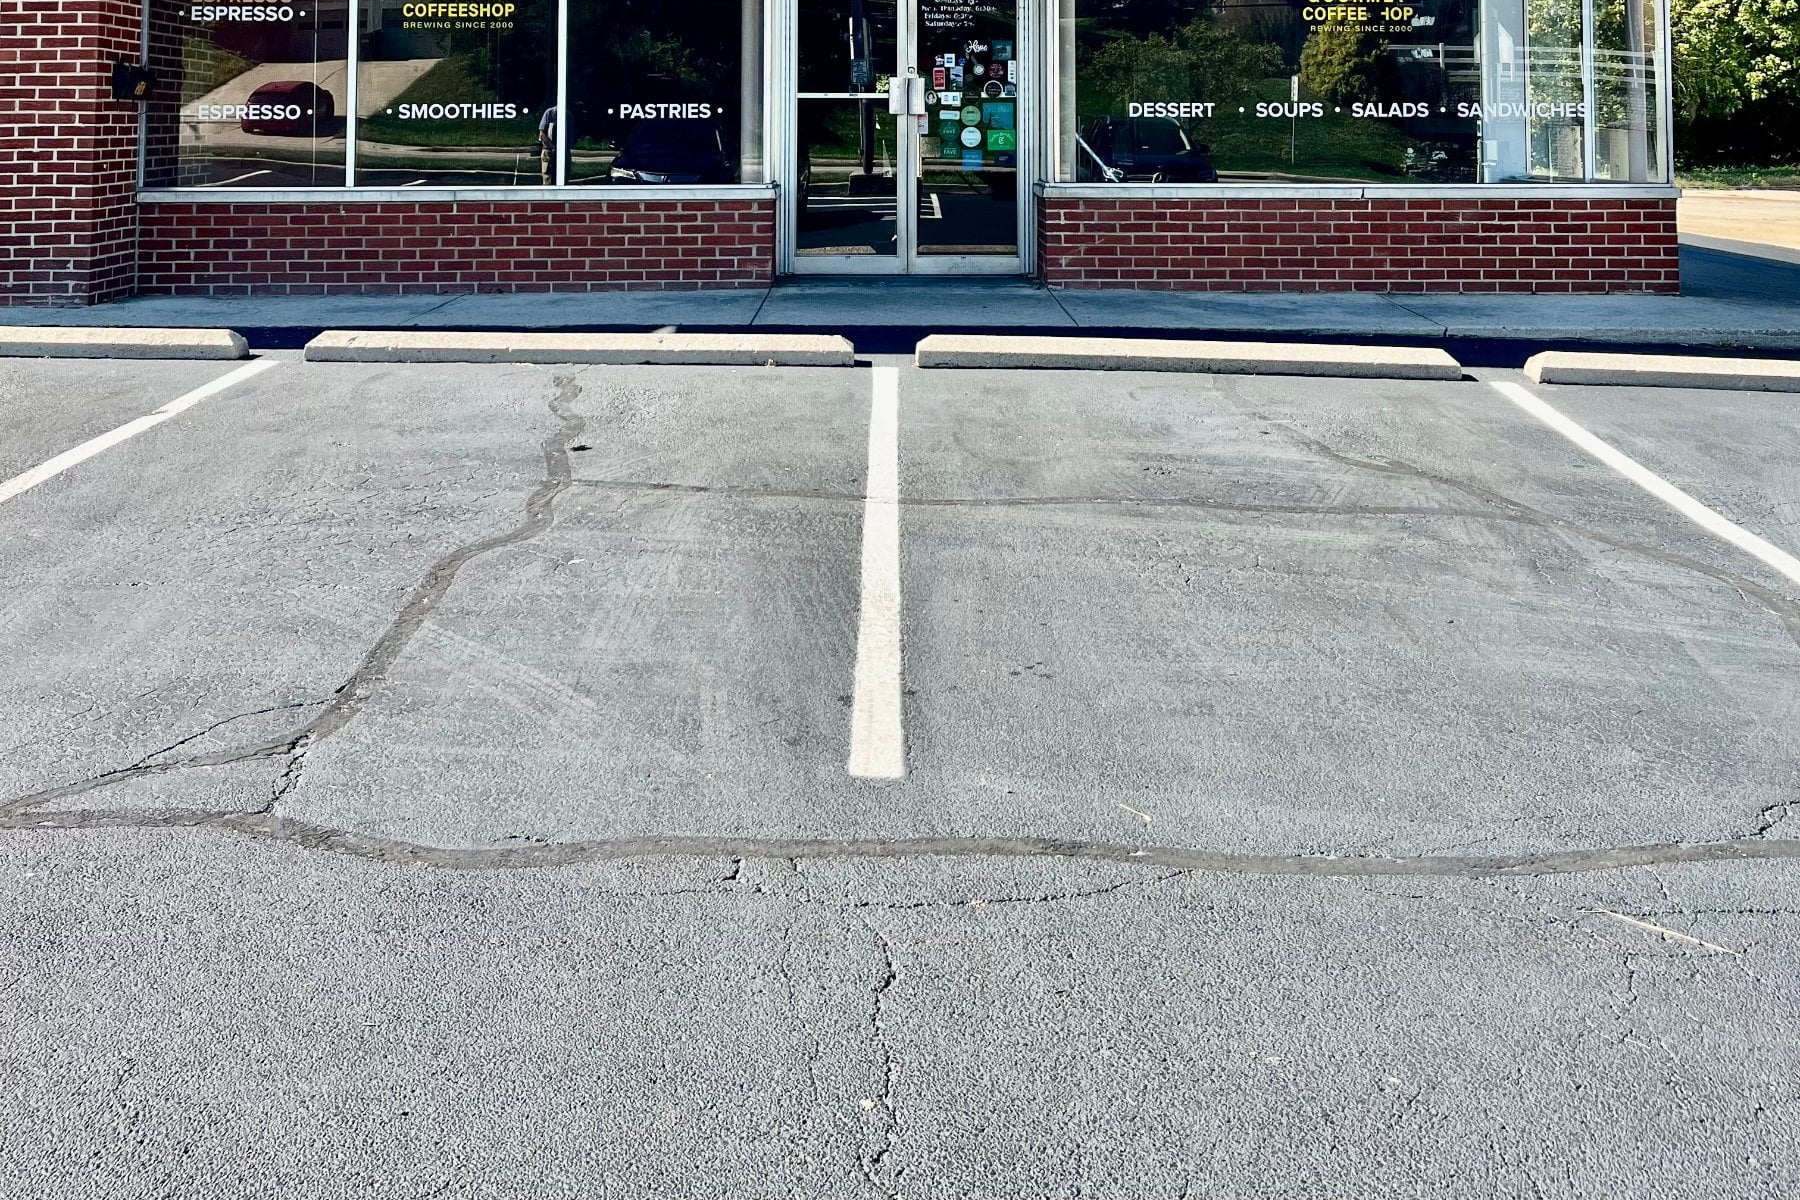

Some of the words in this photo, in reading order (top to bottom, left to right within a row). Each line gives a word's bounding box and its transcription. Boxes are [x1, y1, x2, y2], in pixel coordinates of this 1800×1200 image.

[190, 6, 294, 22] ESPRESSO
[402, 3, 515, 17] COFFEESHOP
[403, 21, 450, 29] BREWING
[455, 21, 486, 29] SINCE
[490, 21, 514, 29] 2000
[198, 104, 301, 120] ESPRESSO
[398, 103, 517, 120] SMOOTHIES
[619, 103, 712, 119] PASTRIES
[1128, 102, 1215, 118] DESSERT
[1255, 102, 1324, 118] SOUPS
[1351, 102, 1429, 118] SALADS
[1457, 102, 1587, 118] SANDWICHES
